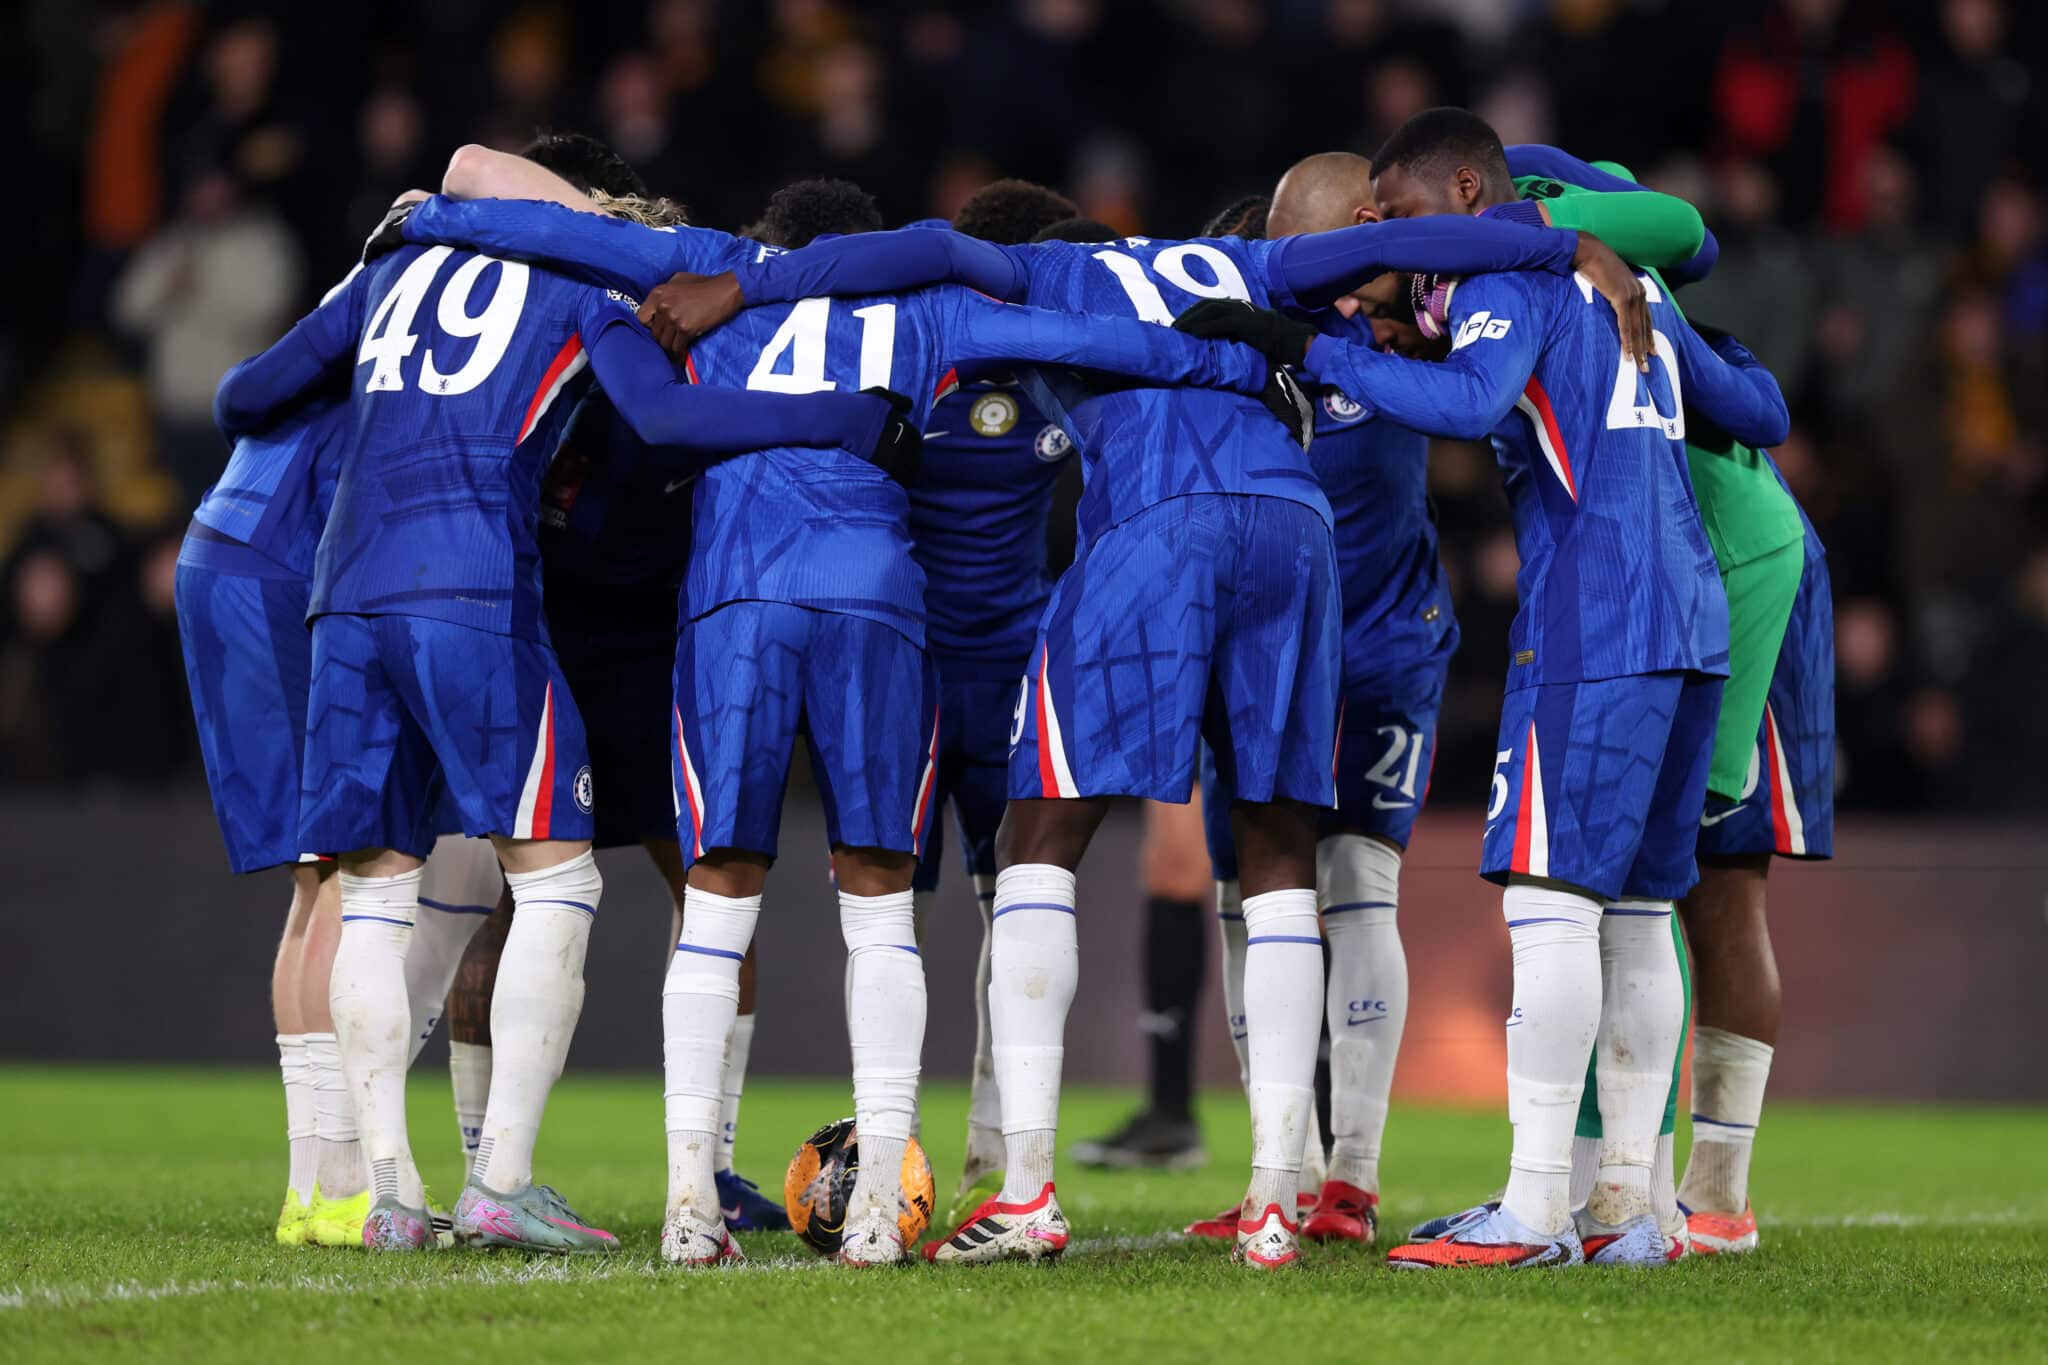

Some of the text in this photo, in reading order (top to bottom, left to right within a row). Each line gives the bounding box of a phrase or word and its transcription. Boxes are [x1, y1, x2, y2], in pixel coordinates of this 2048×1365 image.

[358, 245, 530, 395] 49
[1091, 244, 1252, 328] 19
[746, 297, 896, 395] 41
[1364, 725, 1424, 799] 21
[1230, 1015, 1247, 1026] CF
[1349, 1000, 1388, 1012] CFC
[463, 1126, 482, 1138] CF
